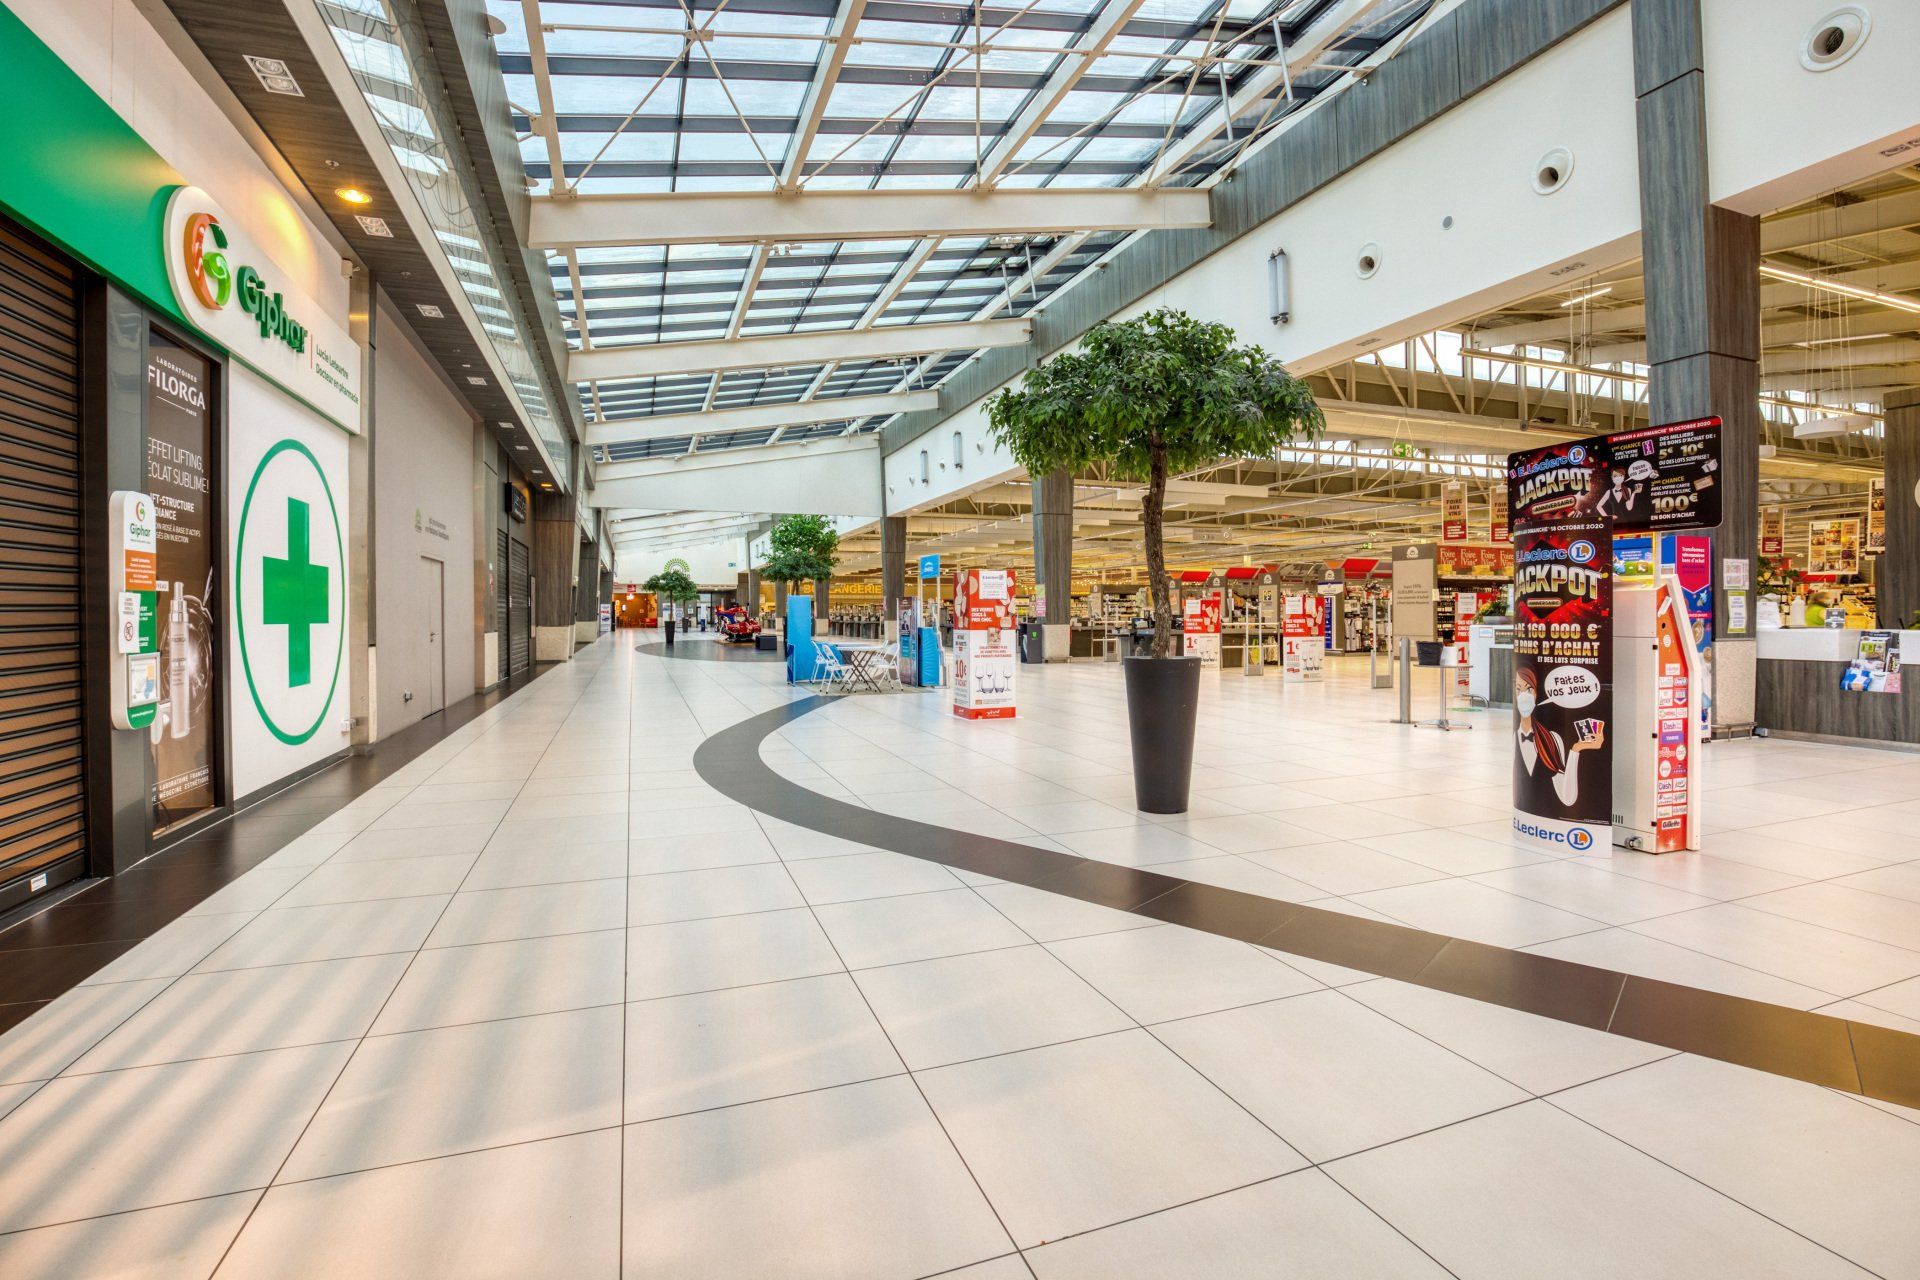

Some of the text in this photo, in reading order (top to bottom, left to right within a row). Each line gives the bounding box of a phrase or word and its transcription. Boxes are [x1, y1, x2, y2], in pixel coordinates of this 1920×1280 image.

[237, 265, 308, 353] Giphar
[156, 355, 197, 382] LABORATOIRES
[148, 364, 206, 410] FILORGA
[316, 363, 333, 385] Docteur
[339, 383, 359, 405] pharmacie
[1674, 424, 1696, 432] OCTOBRE
[1660, 432, 1694, 442] DES MILLIERS
[1620, 442, 1641, 451] CHANCE
[1680, 442, 1704, 456] 10€
[173, 446, 204, 473] LIFTING,
[1518, 456, 1568, 477] E.Leclerc
[173, 468, 209, 493] SUBLIME!
[1662, 476, 1684, 485] CHANCE
[1515, 468, 1592, 509] JACKPOT
[150, 492, 195, 512] IFT-STRUCTURE
[1534, 499, 1574, 513] ANNIVERSAIRE
[1652, 492, 1698, 513] 100€
[130, 523, 151, 537] Giphar
[1440, 548, 1456, 558] Foire
[1460, 549, 1476, 558] Foire
[803, 583, 882, 594] BANGERIE
[1515, 564, 1602, 601] JACKPOT
[1528, 623, 1546, 638] 160
[1550, 623, 1581, 639] 000
[1520, 640, 1600, 657] BONS D'ACHAT
[1570, 657, 1599, 665] SURPRISE
[1554, 675, 1585, 686] Faites
[1664, 722, 1676, 730] Dash
[160, 774, 189, 791] LABORATOIRE
[1662, 820, 1680, 828] Gillette
